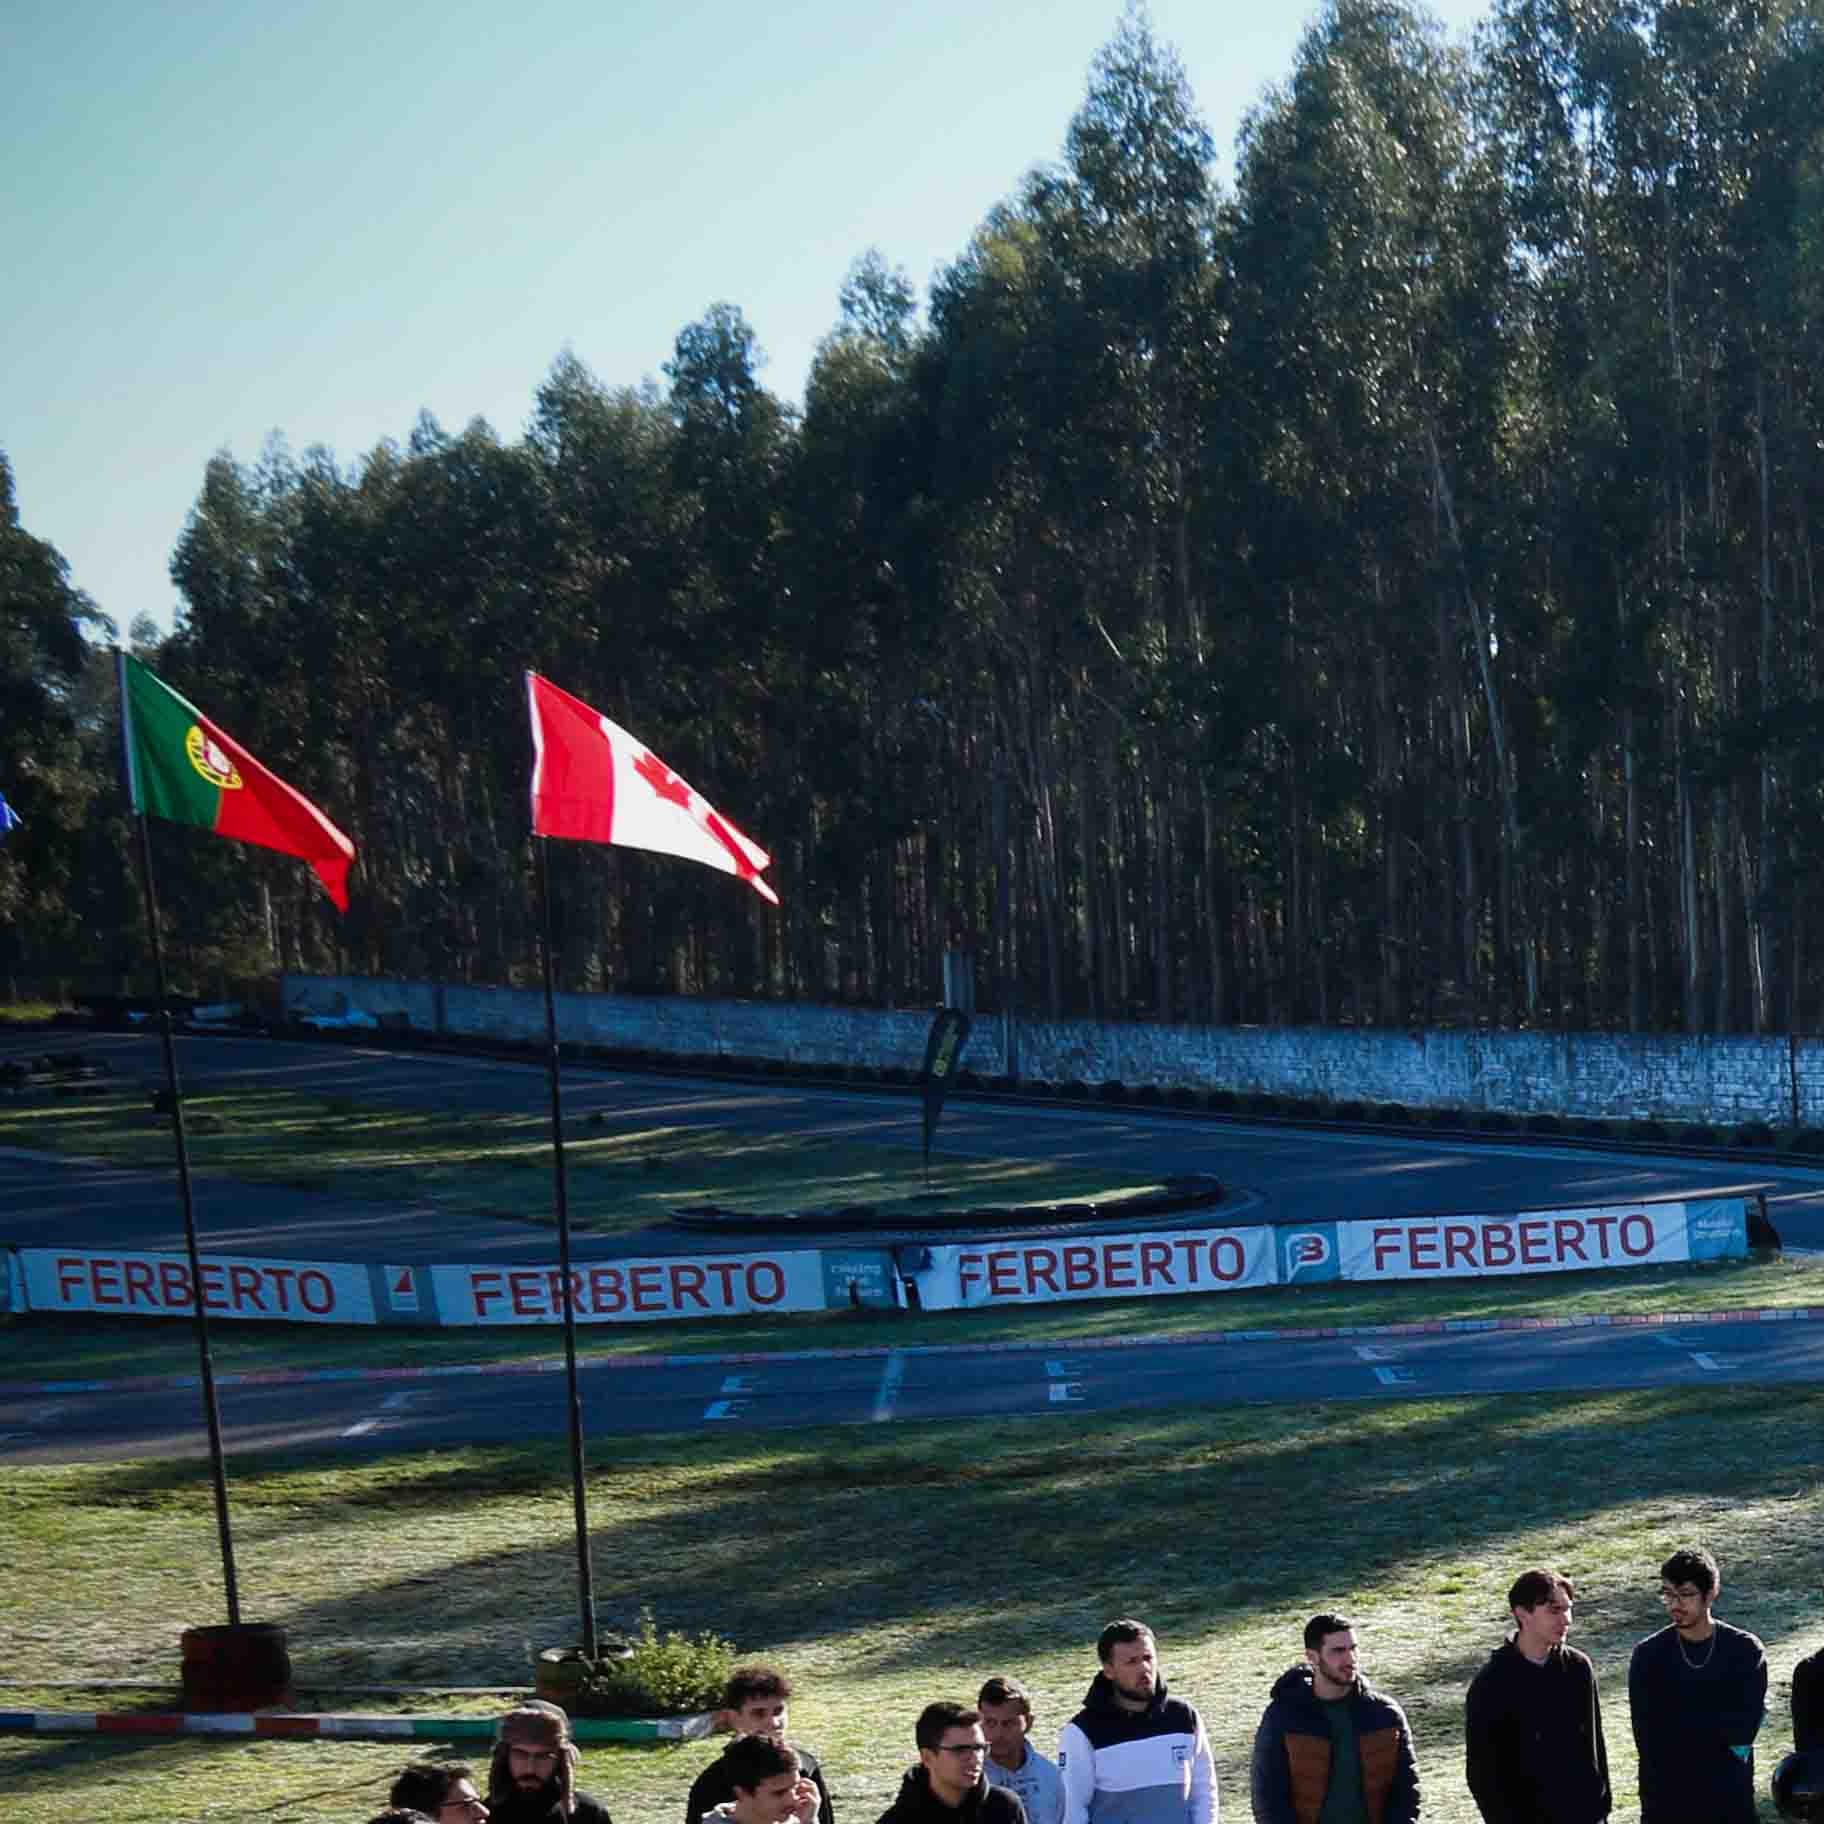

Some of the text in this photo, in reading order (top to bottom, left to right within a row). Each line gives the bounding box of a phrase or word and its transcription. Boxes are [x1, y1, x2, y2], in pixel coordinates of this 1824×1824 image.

[961, 1236, 1244, 1299] FERBERTO
[1374, 1213, 1654, 1271] FERBERTO
[57, 1258, 335, 1315] FERBERTO
[471, 1260, 786, 1317] FERBERTO
